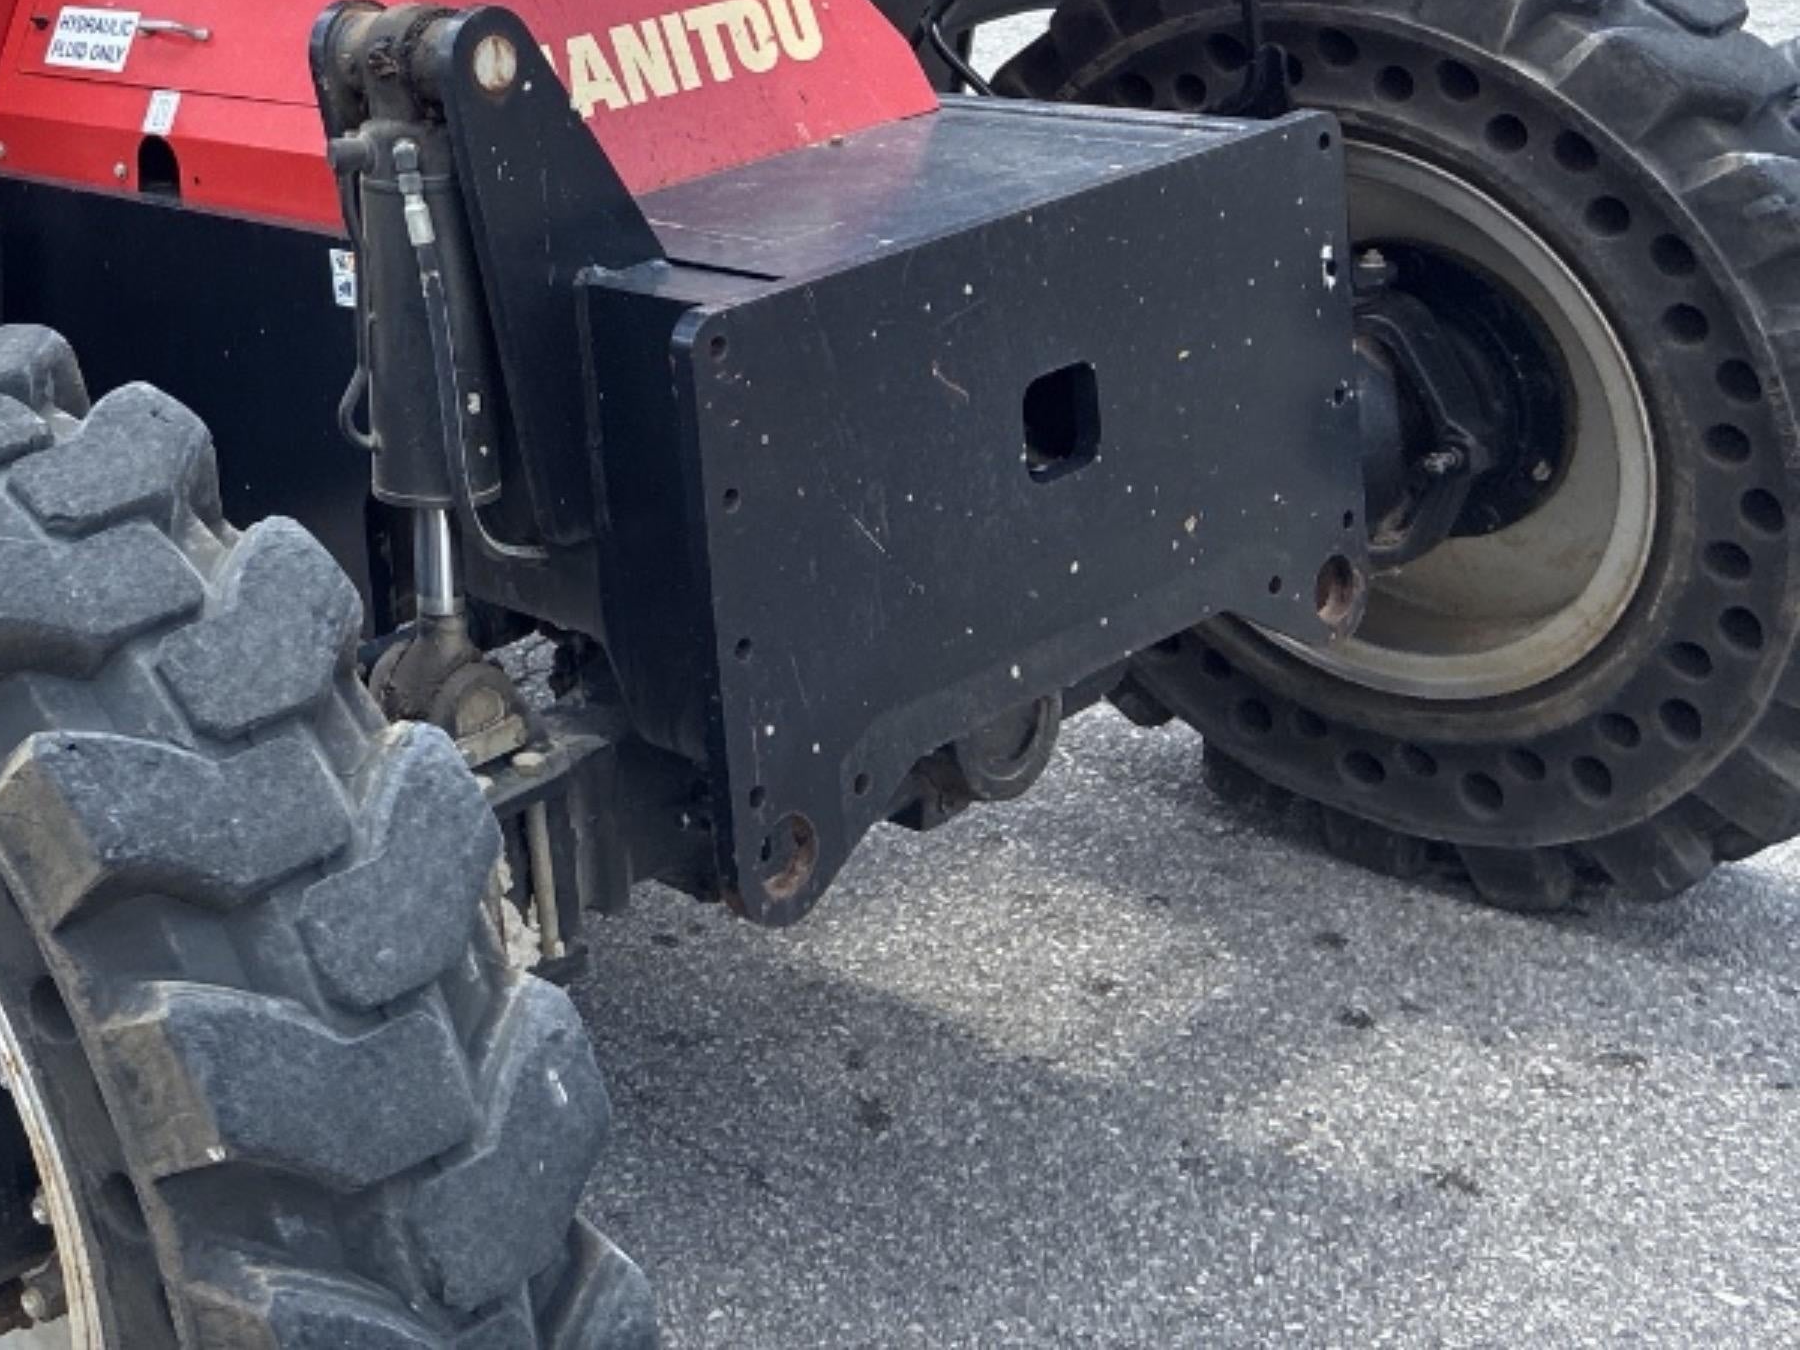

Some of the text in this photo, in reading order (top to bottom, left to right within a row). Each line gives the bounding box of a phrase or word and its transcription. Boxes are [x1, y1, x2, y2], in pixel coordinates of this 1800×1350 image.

[60, 14, 135, 36] HYDRAULIC
[50, 38, 126, 63] FLUID ONLY
